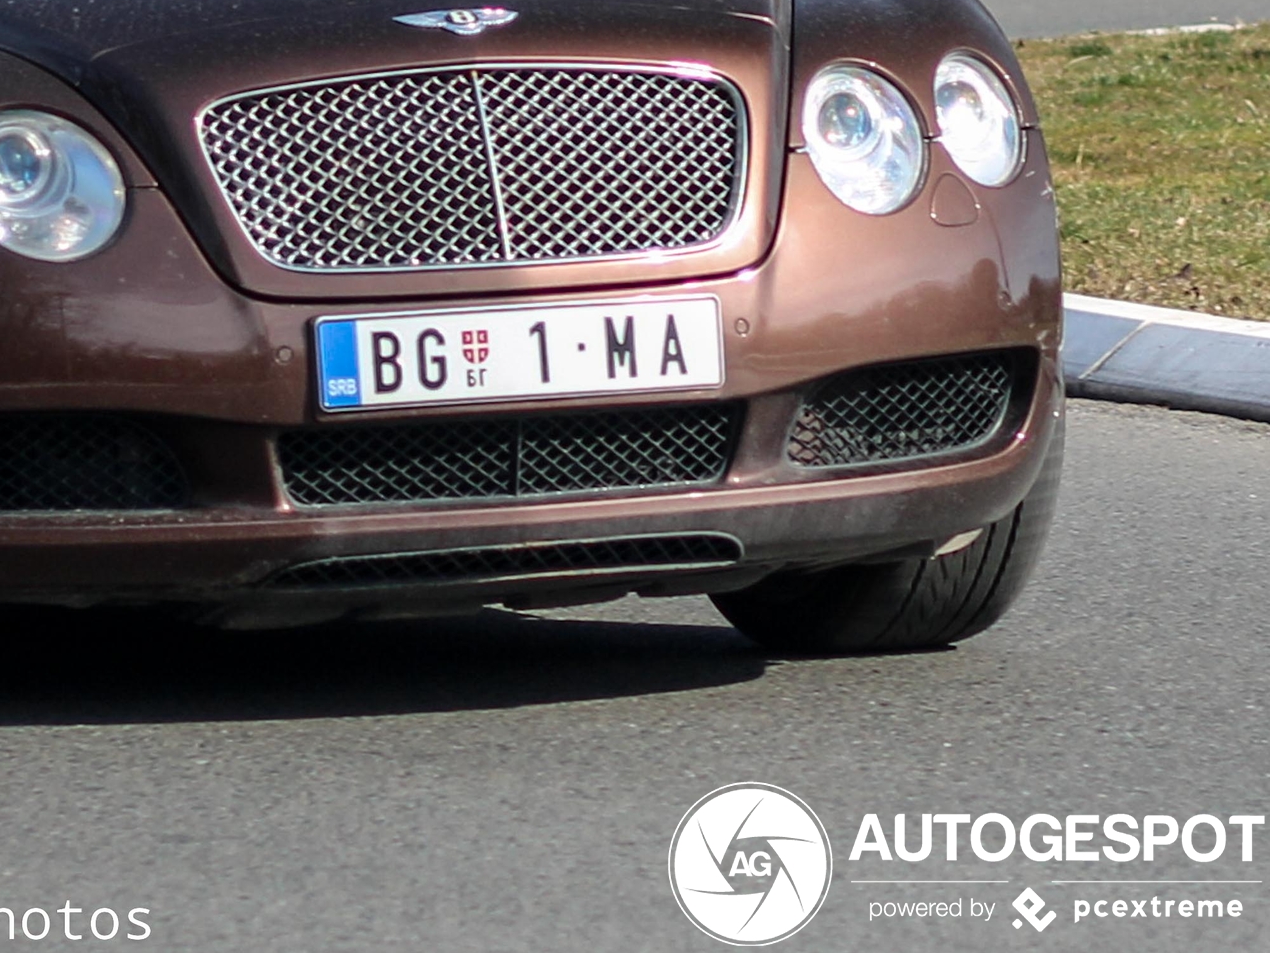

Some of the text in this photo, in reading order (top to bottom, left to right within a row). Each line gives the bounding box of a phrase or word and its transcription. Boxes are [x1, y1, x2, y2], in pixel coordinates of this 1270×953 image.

[370, 328, 448, 394] BG
[328, 378, 358, 396] SRB
[465, 368, 488, 388] БГ
